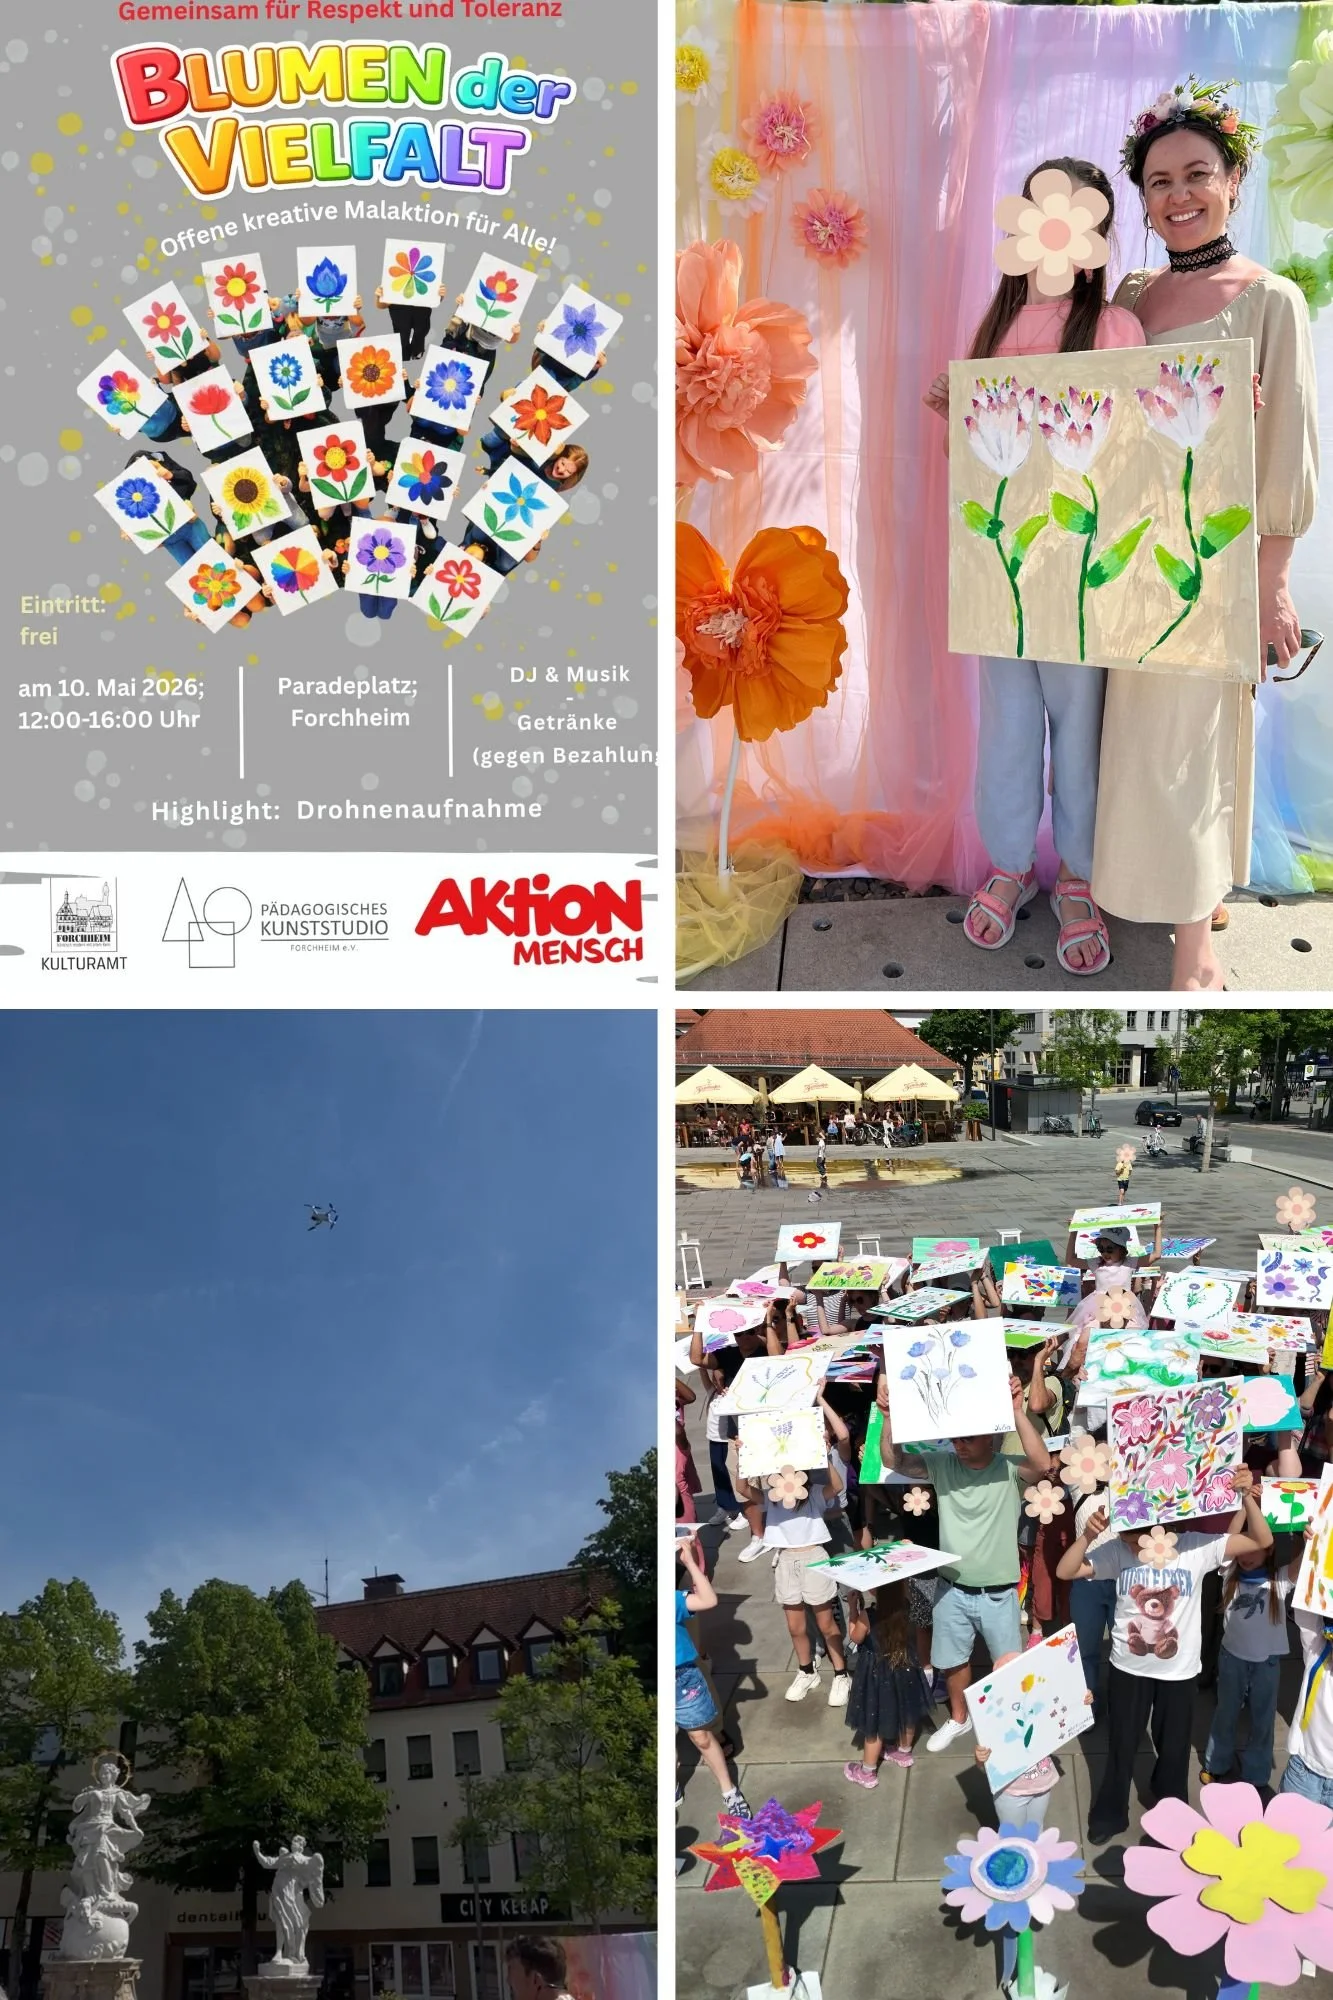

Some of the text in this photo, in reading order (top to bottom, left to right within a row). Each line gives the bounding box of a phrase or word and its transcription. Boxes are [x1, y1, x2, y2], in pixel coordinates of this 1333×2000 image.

[118, 0, 561, 23] Gemeinsam für Respekt und Toleranz
[116, 45, 570, 124] BLUMEN der
[165, 118, 525, 194] VIELFALT
[160, 200, 556, 257] Offene kreative Malaktion für Alle!
[22, 595, 105, 614] Eintritt:
[20, 627, 57, 645] frei
[511, 666, 629, 682] DJ & Musik
[19, 678, 203, 699] am 10. Mai 2026;
[279, 676, 416, 698] Paradeplatz;
[19, 710, 200, 729] 12:00-16:00 Uhr
[293, 708, 409, 726] Forchheim
[518, 712, 617, 731] Getränke
[474, 748, 544, 768] (gegen
[152, 799, 541, 822] Highlight: Drohnenaufnahme
[262, 902, 387, 916] PÄDAGOGISCHES
[262, 920, 388, 936] KUNSTSTUDIO
[57, 934, 110, 942] FORCHHEIM
[513, 937, 643, 966] MENSCH
[42, 957, 127, 970] KULTURAMT
